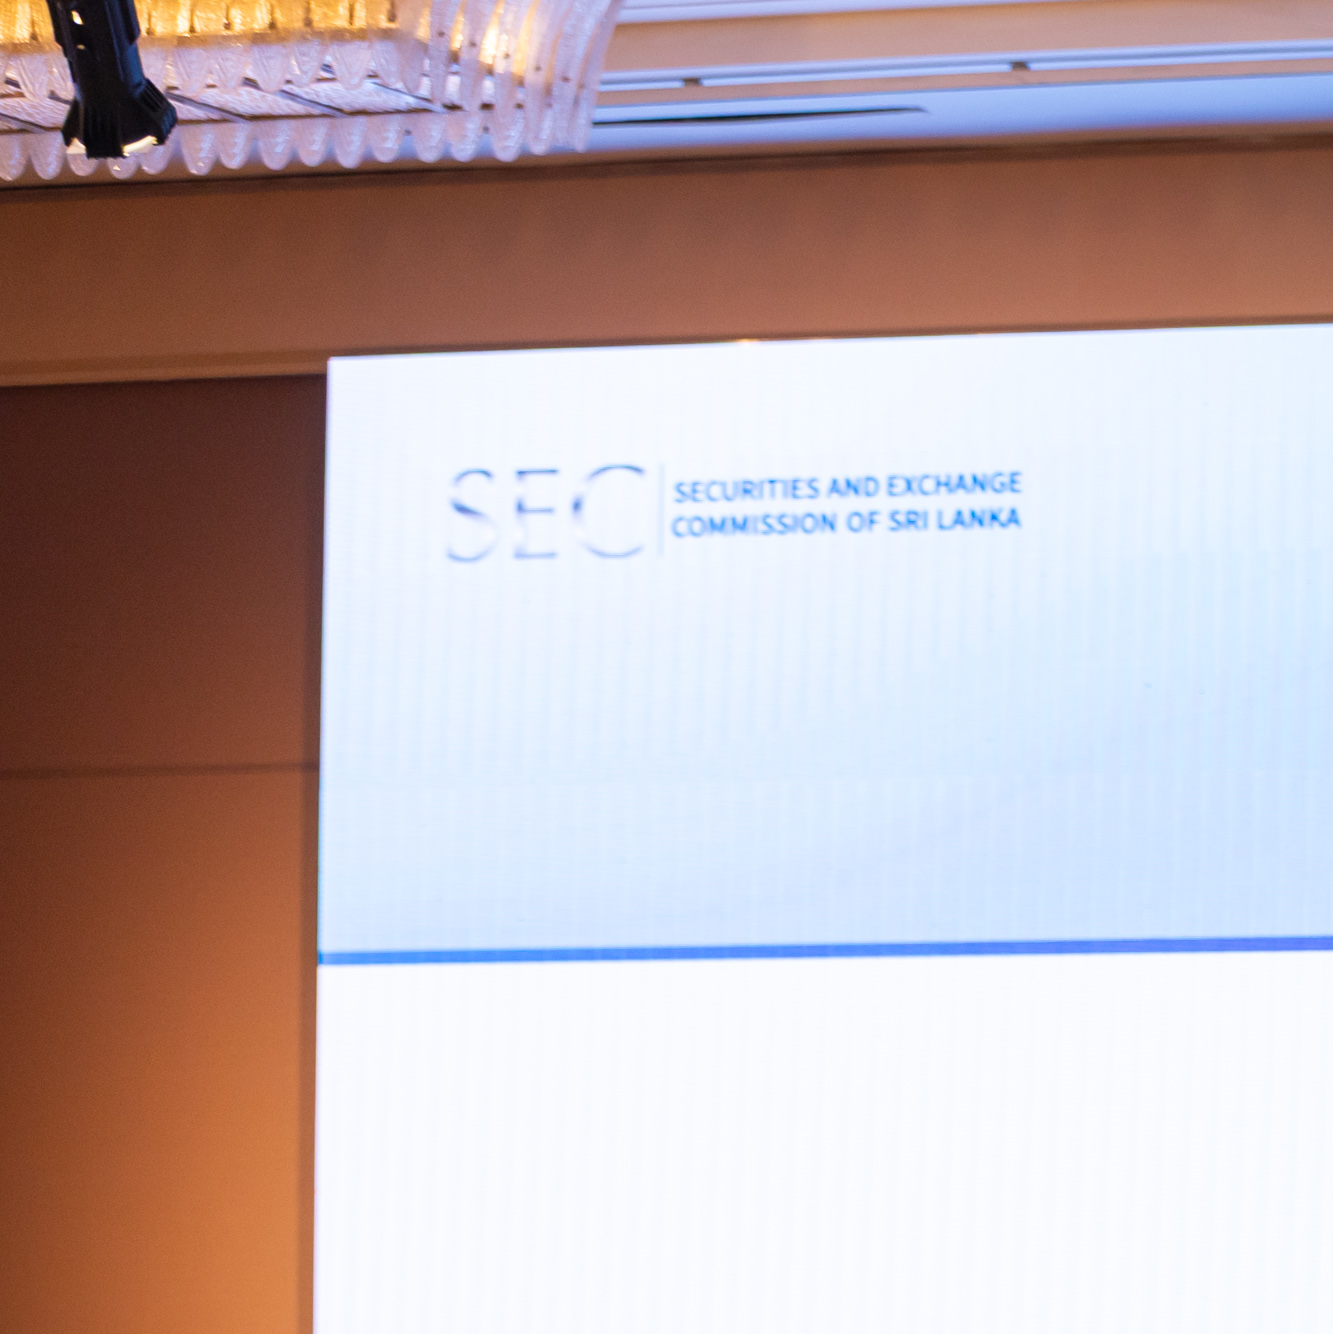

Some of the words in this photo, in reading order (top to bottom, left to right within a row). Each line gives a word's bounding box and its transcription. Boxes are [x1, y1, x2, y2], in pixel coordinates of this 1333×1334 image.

[674, 478, 820, 504] SECURITIES
[826, 476, 880, 500] AND
[887, 472, 1022, 497] EXCHANGE
[446, 464, 646, 563] SEC
[672, 512, 836, 538] COMMISSION
[847, 511, 881, 534] OF
[888, 509, 928, 532] SRI
[937, 507, 1022, 530] LANKA
